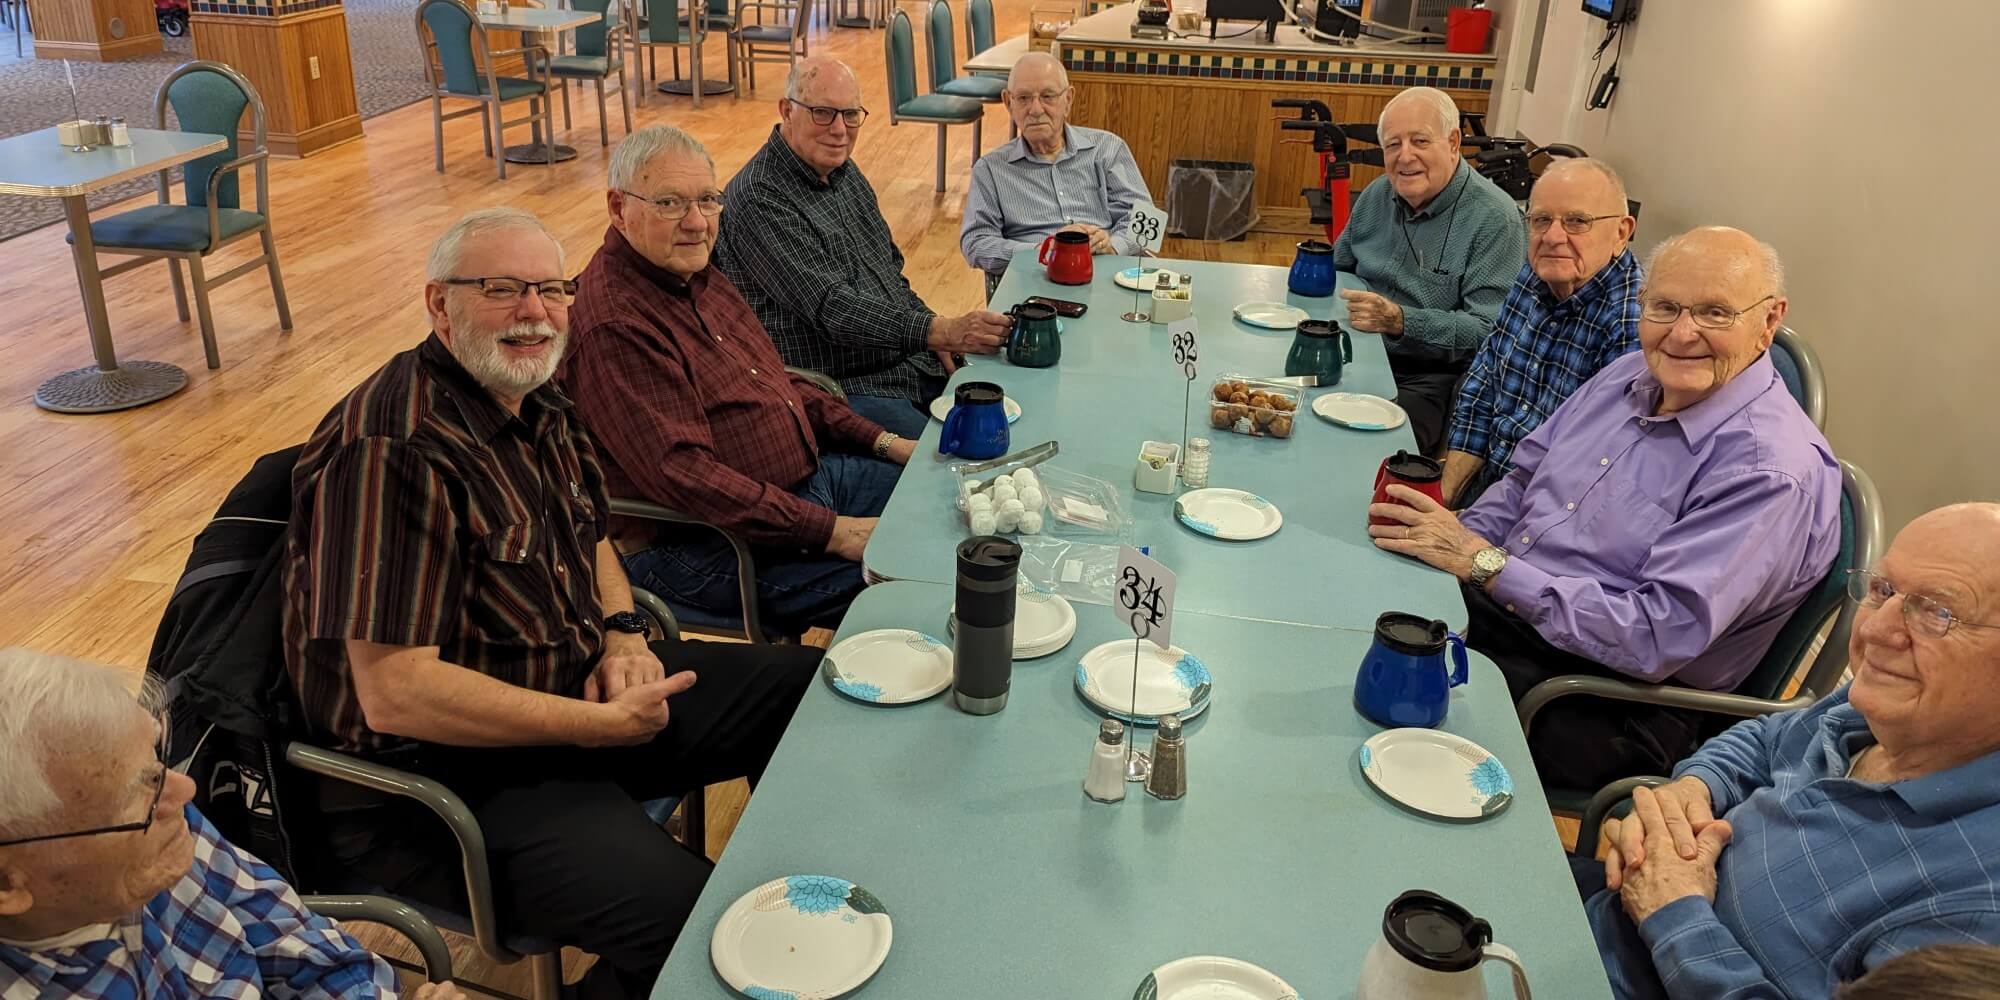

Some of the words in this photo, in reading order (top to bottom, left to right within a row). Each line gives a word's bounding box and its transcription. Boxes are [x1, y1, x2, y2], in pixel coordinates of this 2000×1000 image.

[1132, 211, 1159, 240] 33
[1173, 331, 1197, 364] 32
[1120, 566, 1163, 628] 34
